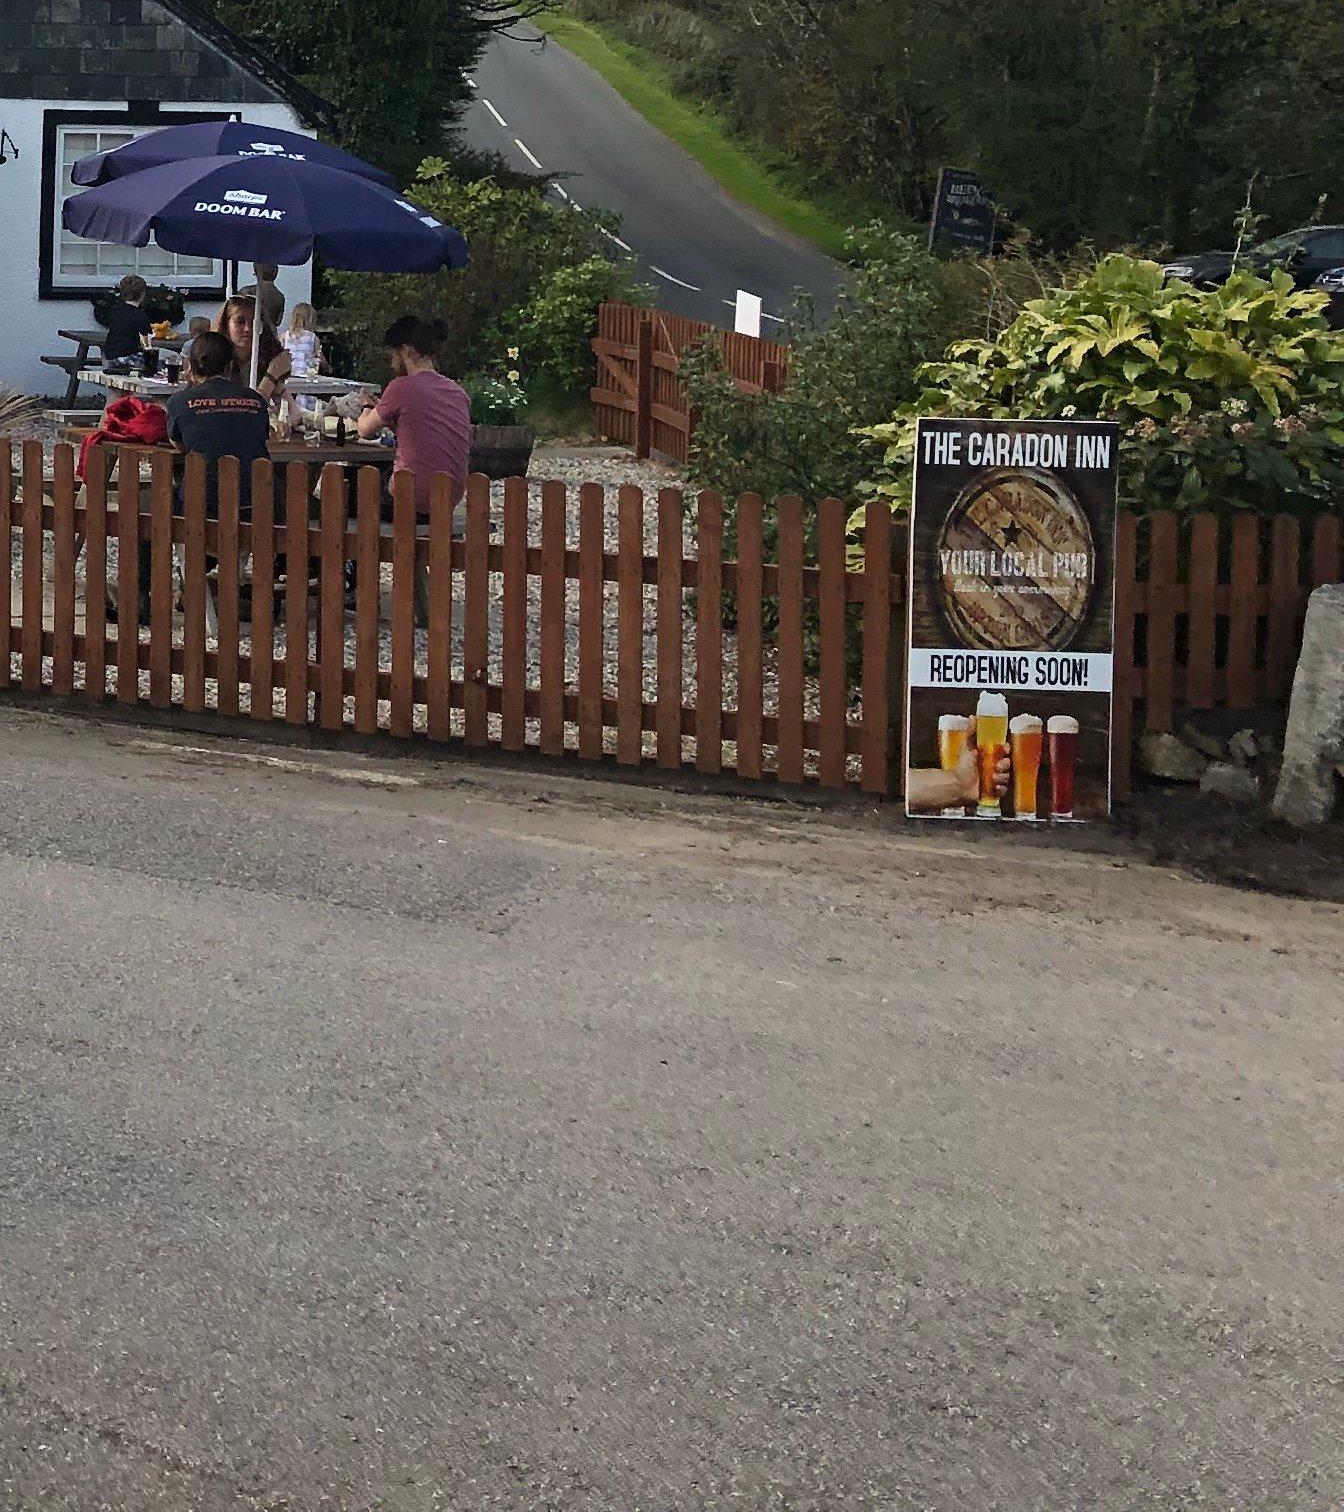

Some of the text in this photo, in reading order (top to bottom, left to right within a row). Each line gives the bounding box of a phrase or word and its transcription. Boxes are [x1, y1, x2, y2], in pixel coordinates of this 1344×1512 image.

[194, 202, 282, 221] DOOM BAR
[922, 431, 1111, 469] THE CARADON INN
[939, 549, 1088, 578] YOUR LOCAL PUB
[930, 654, 1089, 687] REOPENING SOON!
